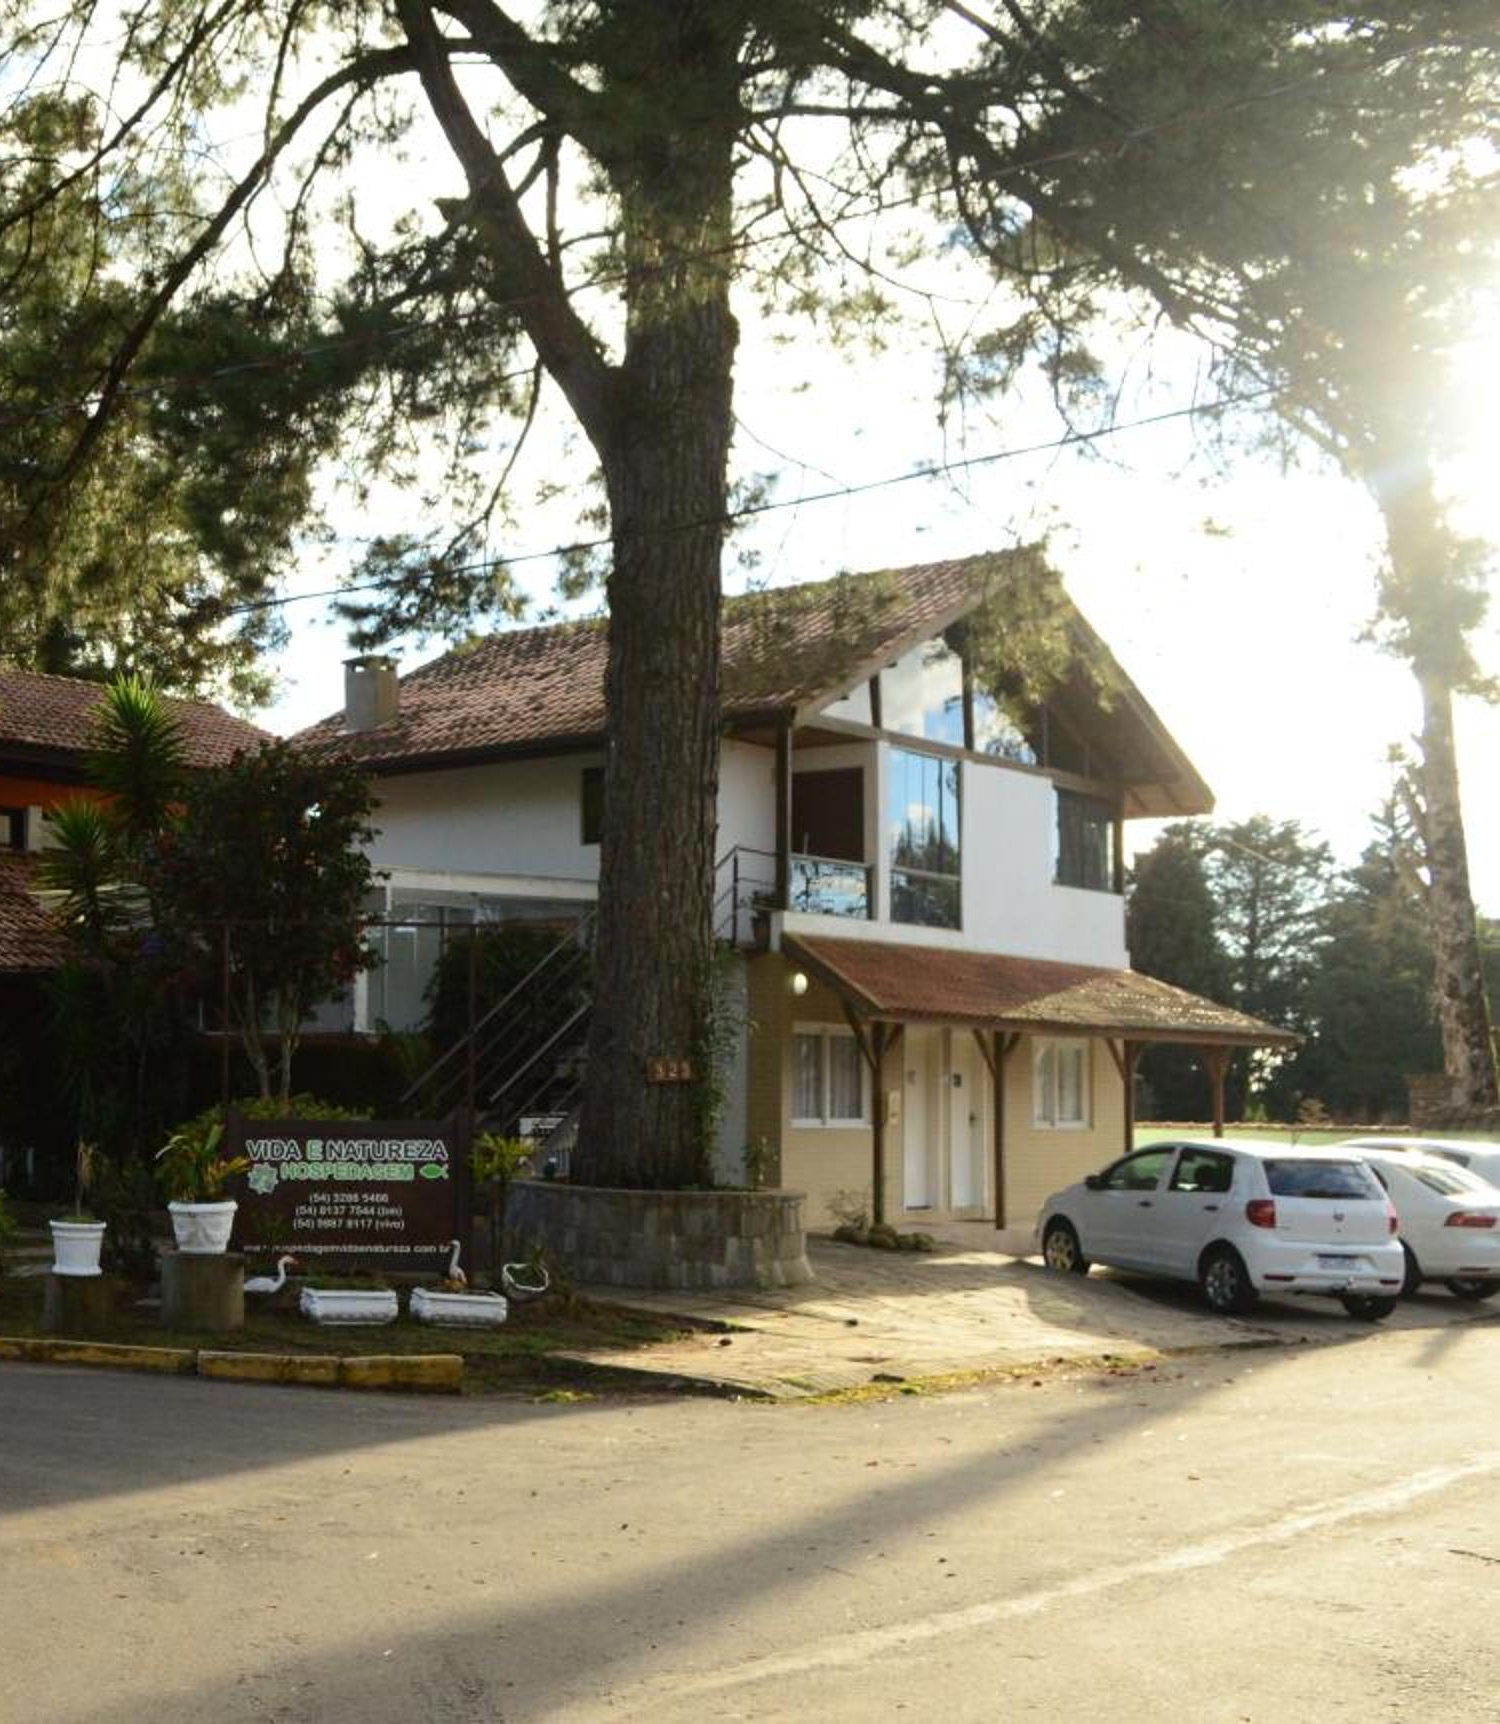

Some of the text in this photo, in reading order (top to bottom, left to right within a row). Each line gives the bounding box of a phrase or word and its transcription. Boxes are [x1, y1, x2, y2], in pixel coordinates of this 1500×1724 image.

[246, 1139, 449, 1161] VIDA E NATUREZA
[280, 1161, 415, 1181] HOSPEDAGEM
[309, 1193, 331, 1204] (54)
[295, 1205, 317, 1217] (54)
[293, 1218, 315, 1230] (54)
[375, 1218, 405, 1230] (vivo)
